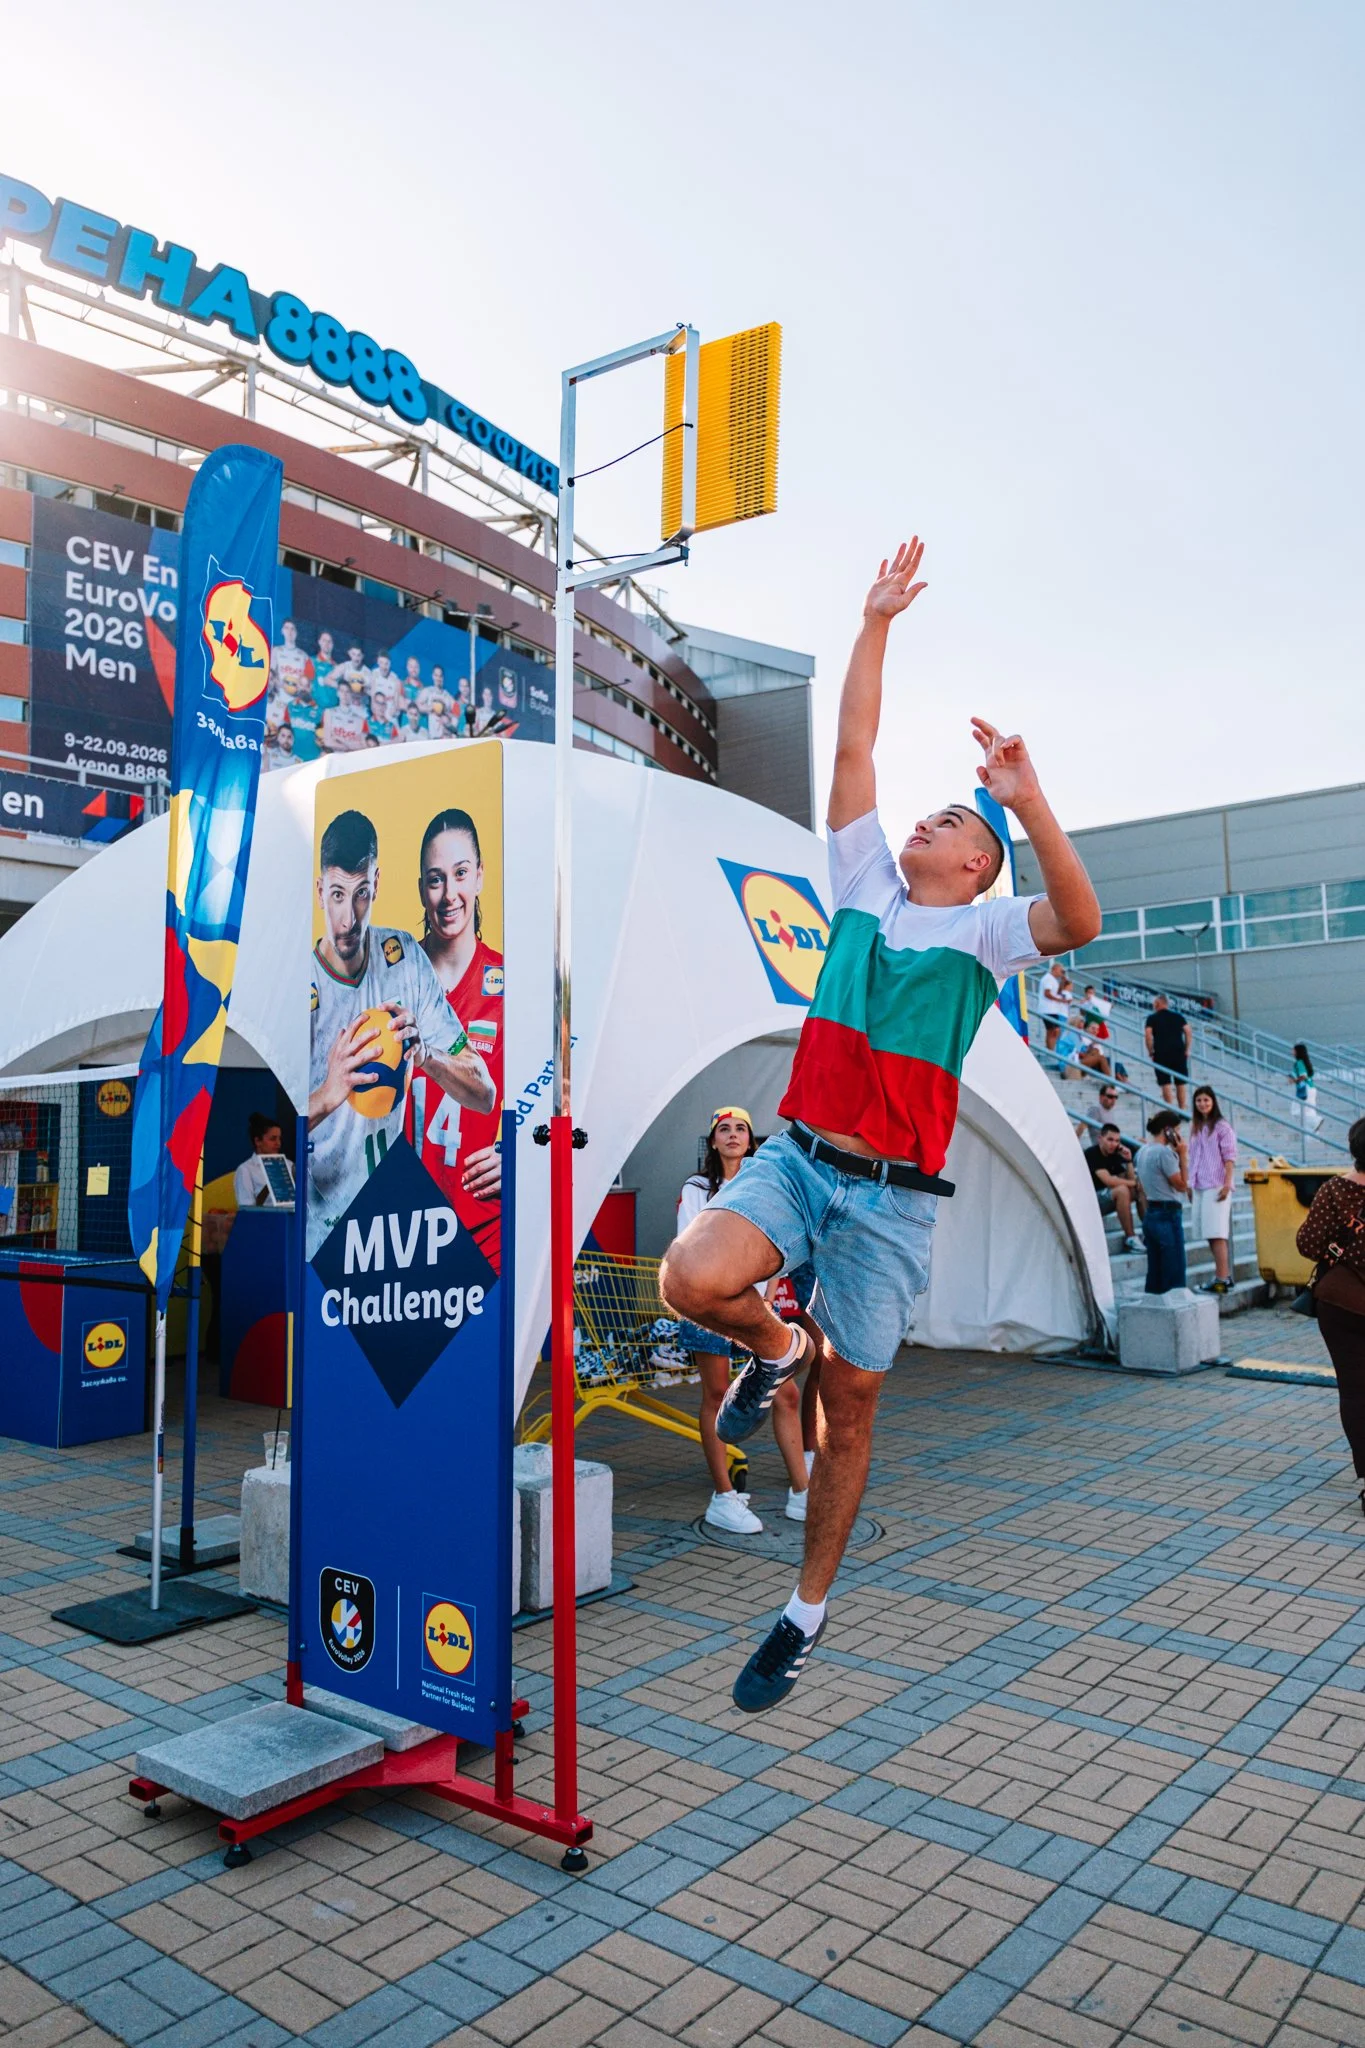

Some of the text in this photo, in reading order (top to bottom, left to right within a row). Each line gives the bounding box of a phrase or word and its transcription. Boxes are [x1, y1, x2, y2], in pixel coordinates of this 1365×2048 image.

[266, 292, 428, 426] 8888
[66, 536, 178, 589] CEV En
[66, 571, 177, 622] EuroVo
[64, 608, 144, 649] 2026
[65, 643, 137, 684] Men
[66, 753, 168, 780] Arena 8888
[2, 790, 44, 819] en
[412, 1077, 462, 1167] 14
[344, 1206, 458, 1274] MVP
[321, 1282, 485, 1328] Challenge
[334, 1577, 360, 1595] CEV
[421, 1680, 476, 1704] National Fresh Food
[421, 1689, 475, 1713] Partner for Bulgaria
